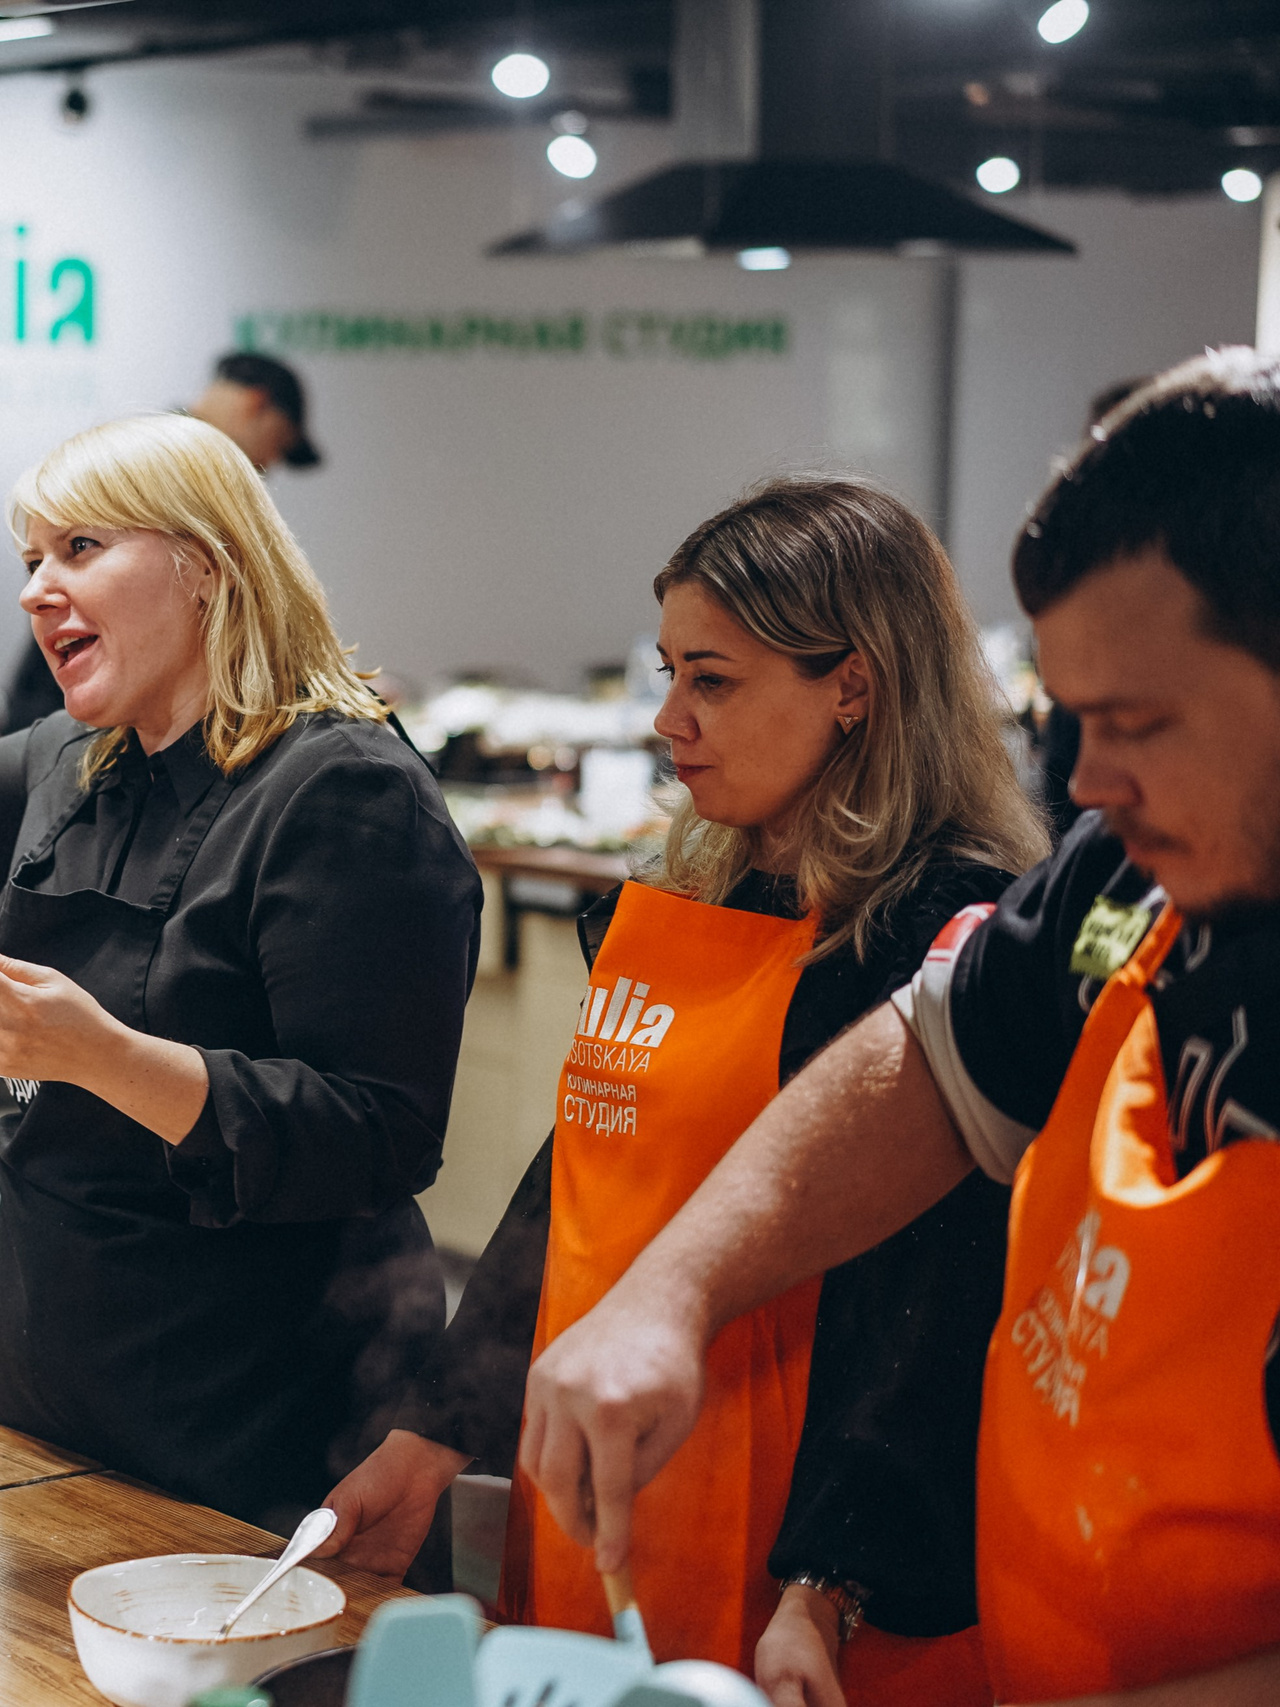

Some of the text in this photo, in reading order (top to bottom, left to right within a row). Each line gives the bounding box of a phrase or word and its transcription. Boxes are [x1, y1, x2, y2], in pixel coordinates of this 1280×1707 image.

[577, 976, 676, 1048] ulia
[567, 1039, 651, 1073] SOTSKAYA
[563, 1094, 637, 1138] СТУДИЯ
